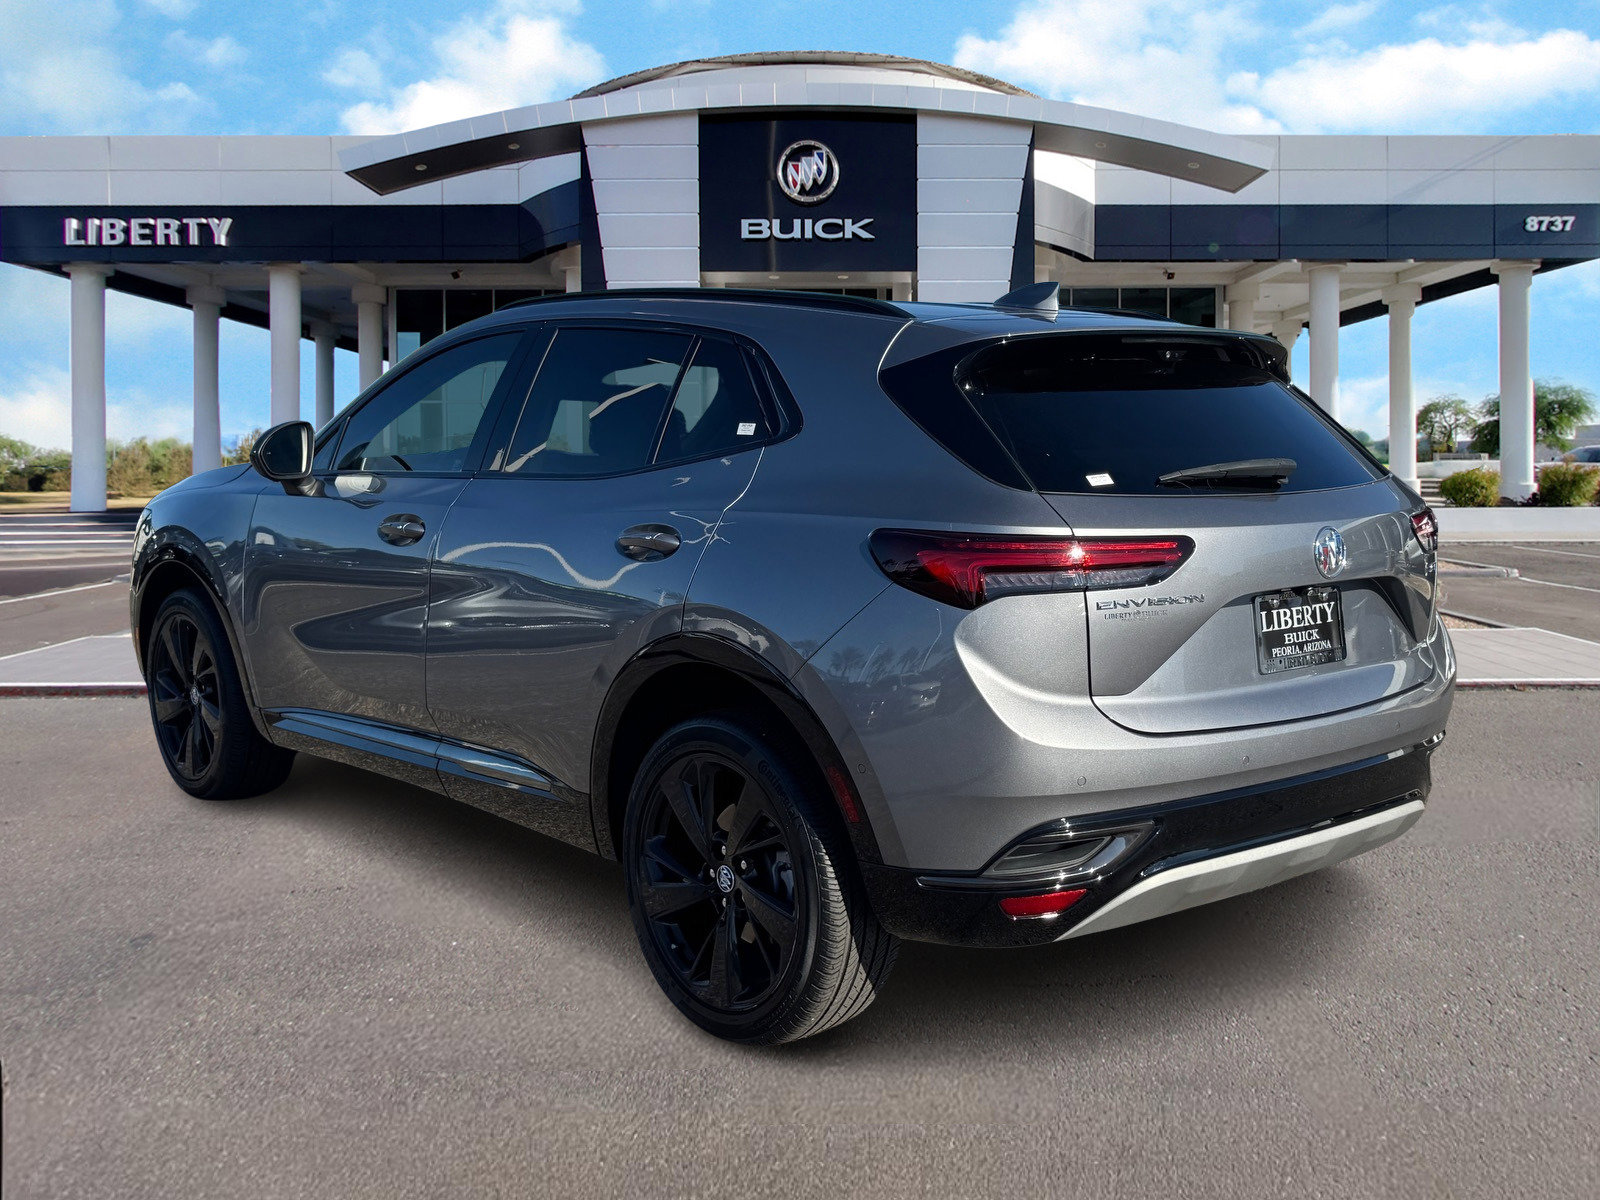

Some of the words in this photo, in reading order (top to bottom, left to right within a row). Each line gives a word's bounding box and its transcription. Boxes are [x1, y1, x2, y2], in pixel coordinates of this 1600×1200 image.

[63, 217, 233, 247] LIBERTY
[740, 218, 876, 239] BUICK
[1524, 215, 1576, 232] 8737
[1096, 594, 1205, 611] ENVISION
[1104, 611, 1132, 620] LIBERTY
[1260, 602, 1335, 633] LIBERTY
[1284, 629, 1320, 645] BUICK
[1272, 644, 1302, 658] PEORIA,
[1303, 640, 1332, 653] ARIZONA
